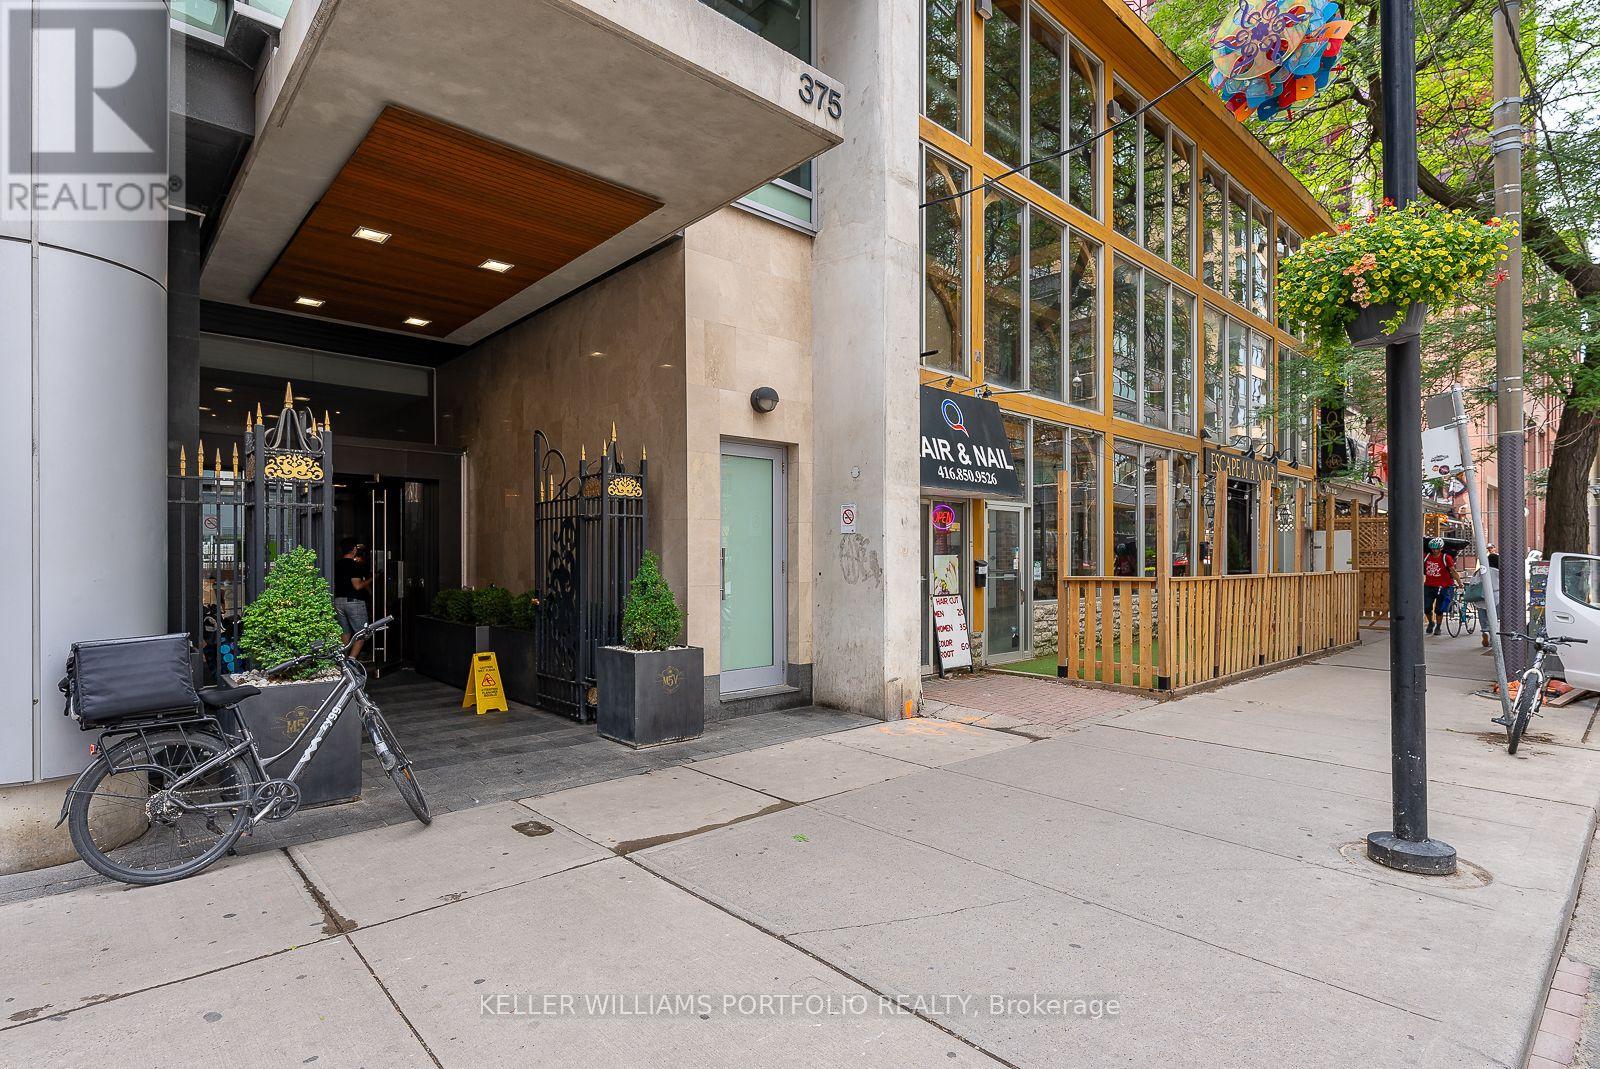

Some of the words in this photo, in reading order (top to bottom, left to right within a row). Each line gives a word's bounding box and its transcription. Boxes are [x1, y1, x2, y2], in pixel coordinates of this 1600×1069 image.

[799, 73, 841, 119] 375
[920, 435, 954, 462] AIR
[957, 442, 972, 466] &
[972, 444, 1014, 471] NAIL
[1211, 452, 1241, 478] ESCAPE
[937, 465, 998, 485] 416.850.9526
[932, 511, 952, 524] OPEN
